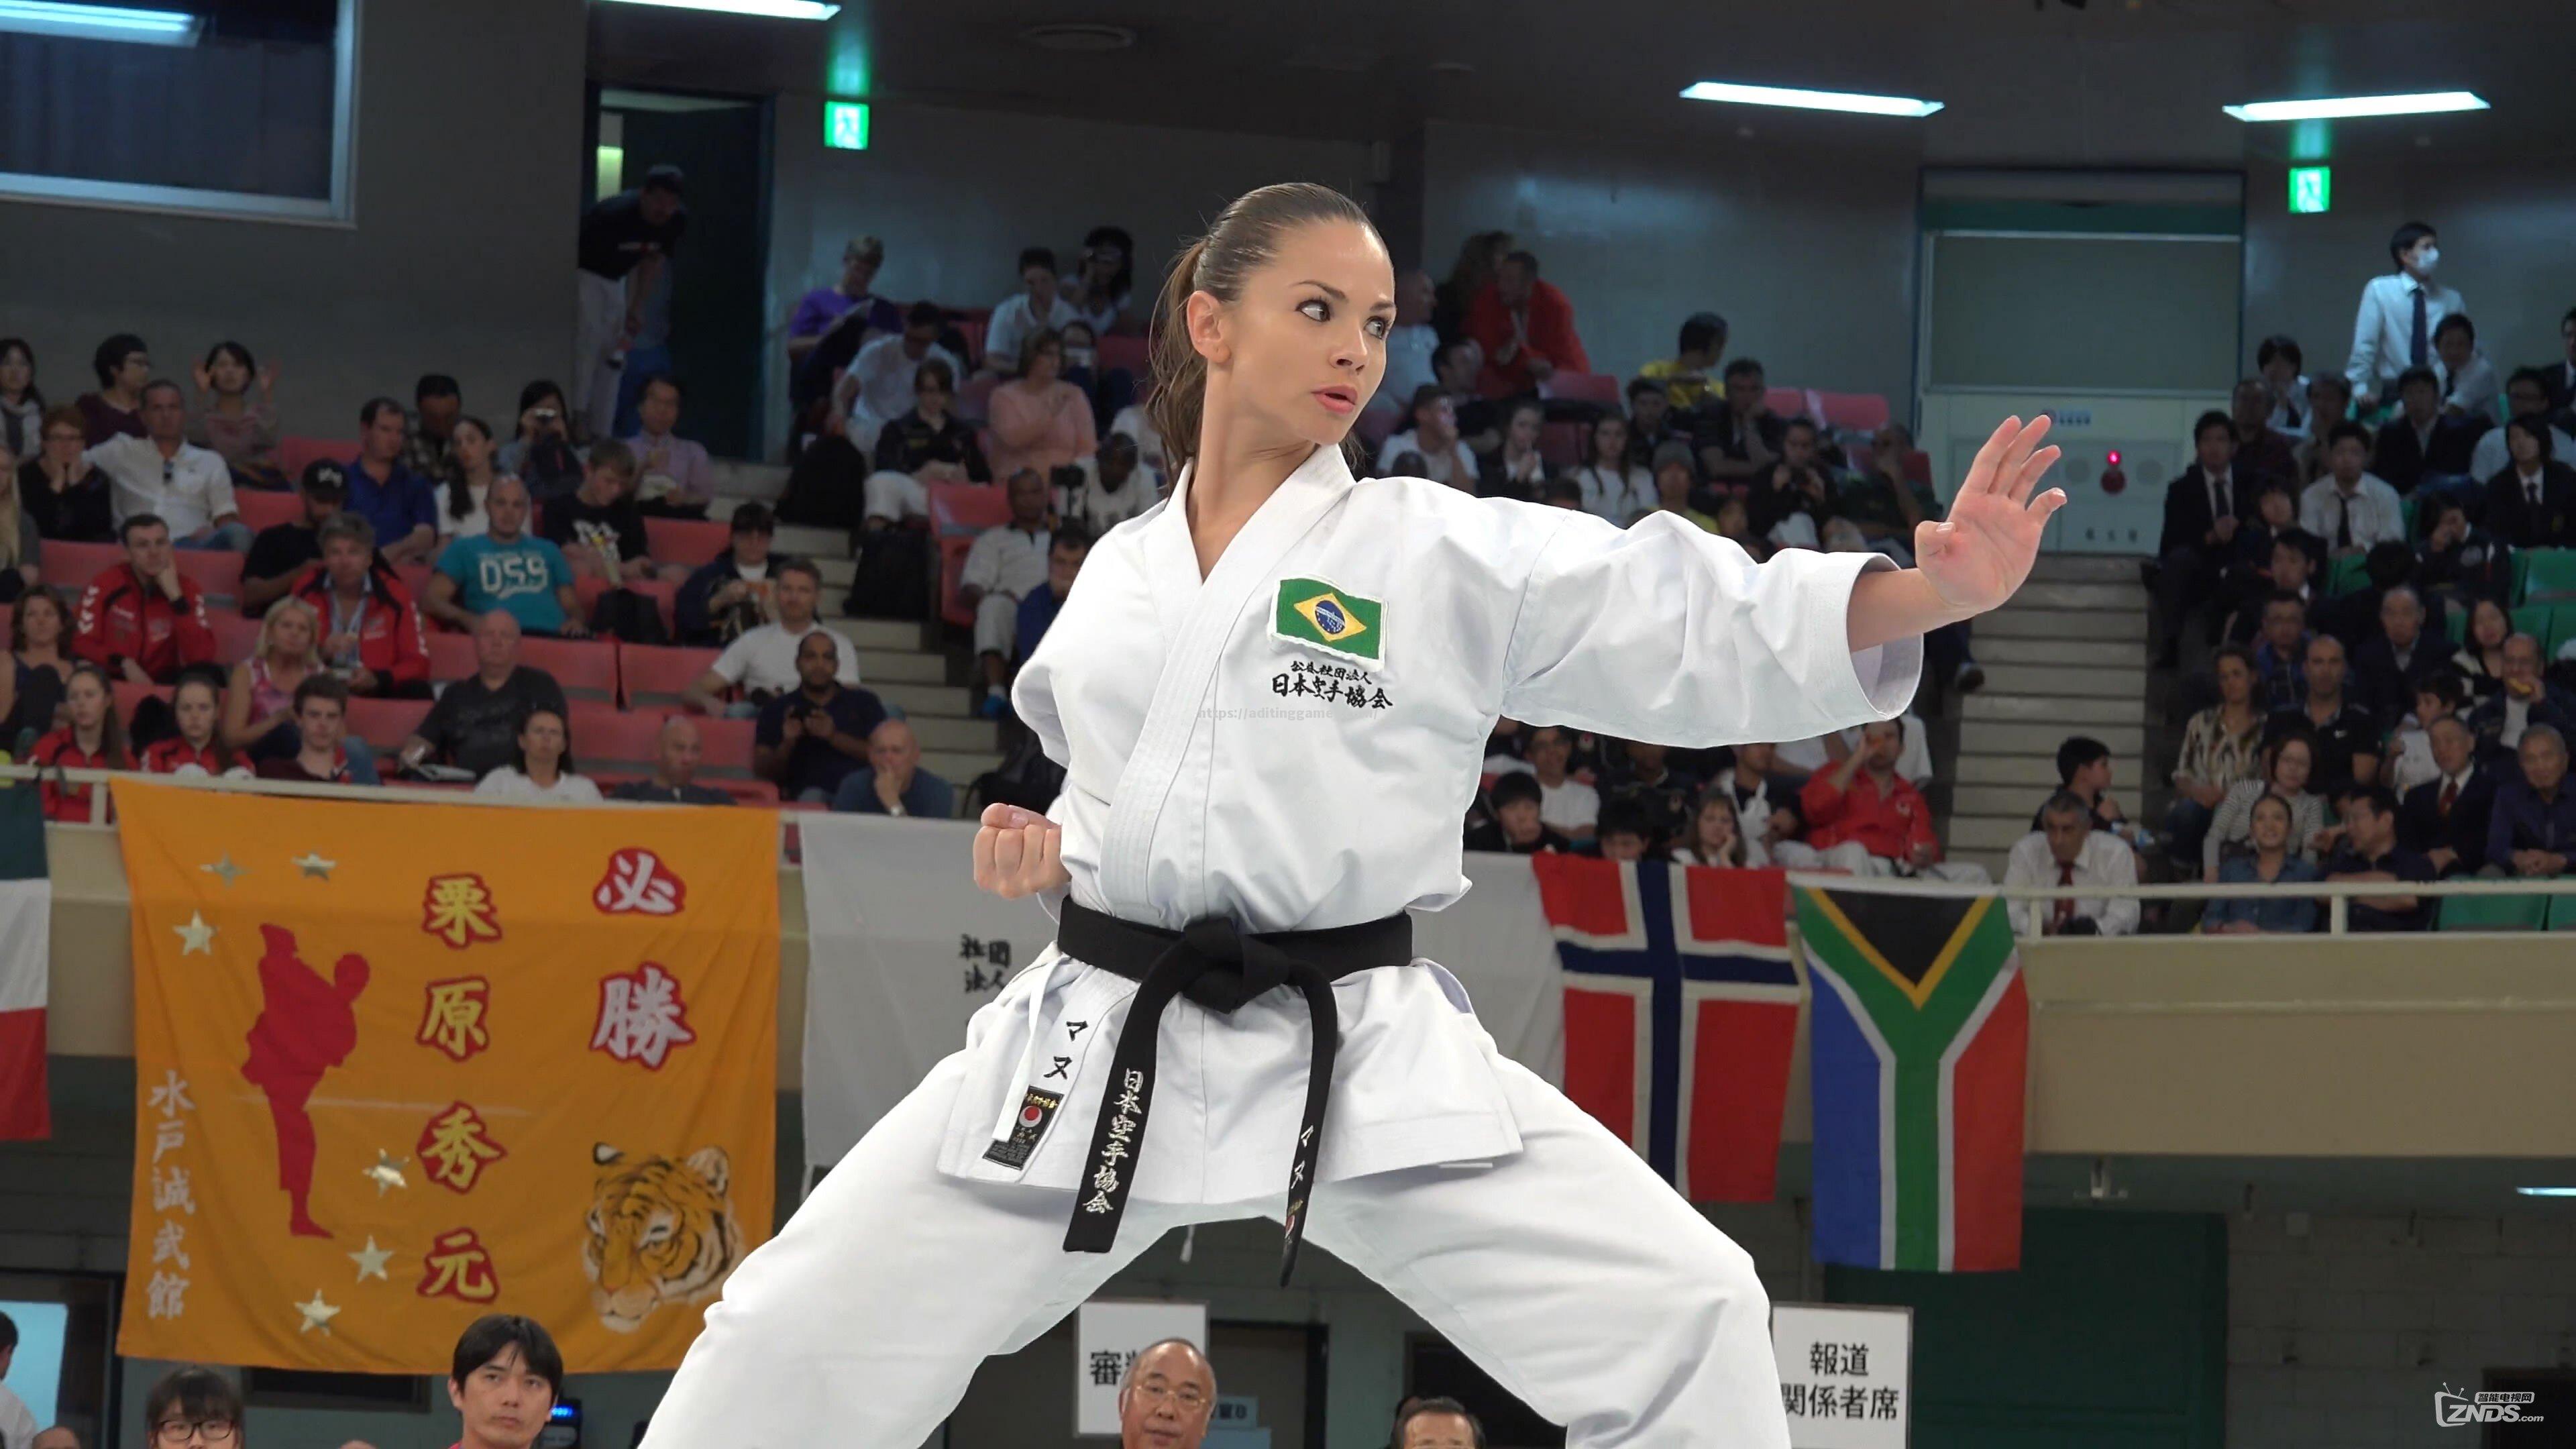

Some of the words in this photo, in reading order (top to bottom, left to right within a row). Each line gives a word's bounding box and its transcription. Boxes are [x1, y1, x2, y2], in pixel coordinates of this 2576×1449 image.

[1272, 672, 1393, 709] 日本空手協会
[596, 851, 694, 1068] 必勝
[1043, 1020, 1089, 1080] マヌ
[421, 877, 500, 1300] 栗原秀元
[1083, 1067, 1144, 1214] 日本空手協会
[147, 1069, 196, 1320] 水戸誠武館
[1090, 1350, 1139, 1386] 審
[1810, 1340, 1870, 1376] 報道
[1781, 1383, 1900, 1420] 関係者席
